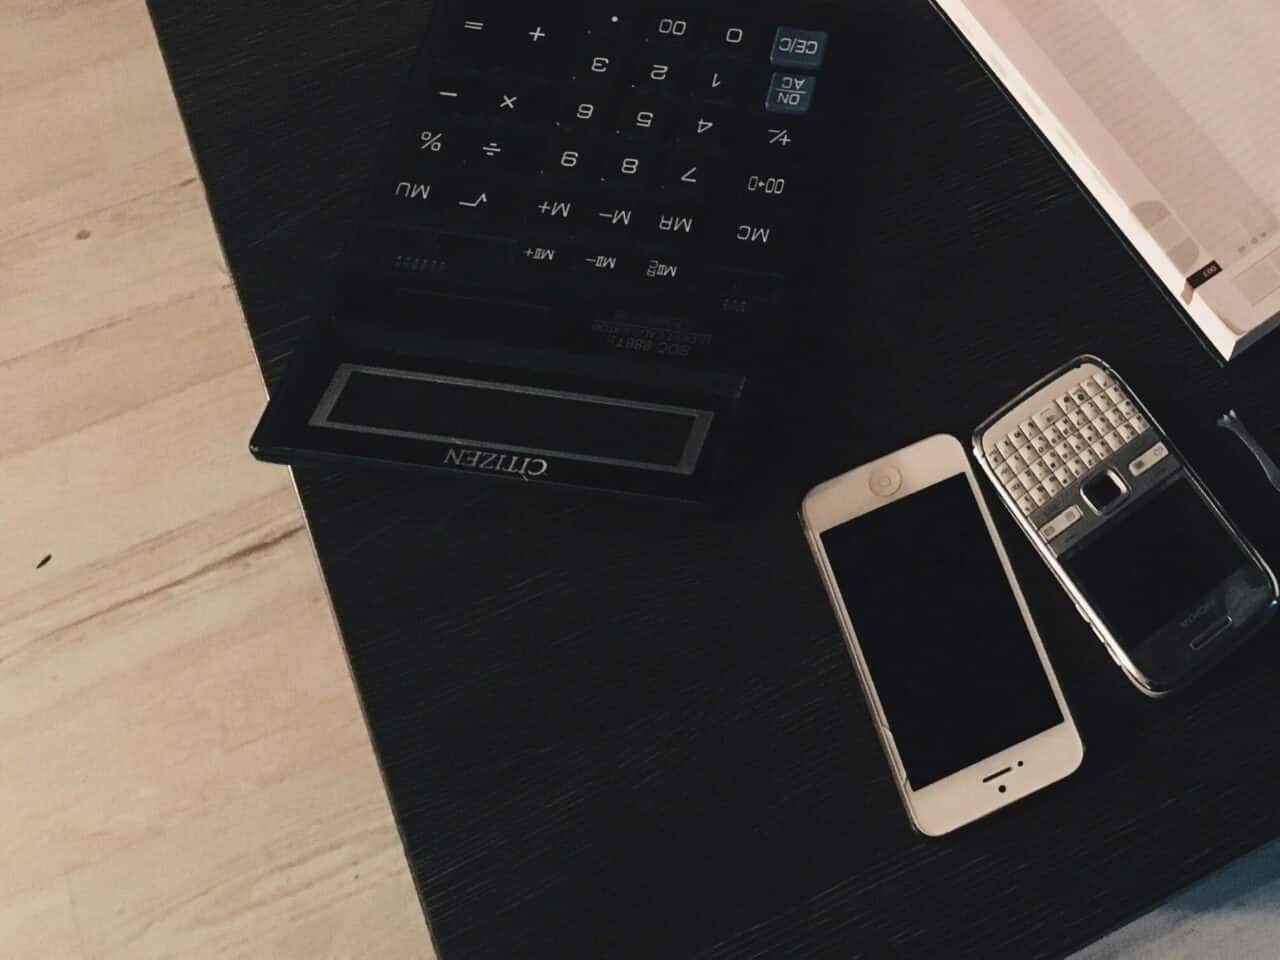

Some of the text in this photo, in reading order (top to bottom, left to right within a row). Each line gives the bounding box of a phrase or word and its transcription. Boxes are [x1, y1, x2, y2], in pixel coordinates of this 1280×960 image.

[659, 19, 686, 35] 00
[779, 38, 818, 54] CE/C
[592, 57, 608, 72] 3
[651, 65, 668, 79] 2
[712, 74, 720, 87] 1
[778, 77, 805, 89] AC
[776, 92, 802, 106] ON
[577, 104, 593, 118] 6
[637, 112, 653, 127] 5
[697, 120, 712, 133] 4
[561, 152, 578, 166] 9
[622, 158, 638, 173] 8
[681, 168, 696, 182] 7
[396, 183, 430, 199] MU
[539, 202, 570, 217] M+
[659, 216, 692, 232] MR
[738, 226, 769, 242] MC
[443, 446, 548, 481] CITIZEN
